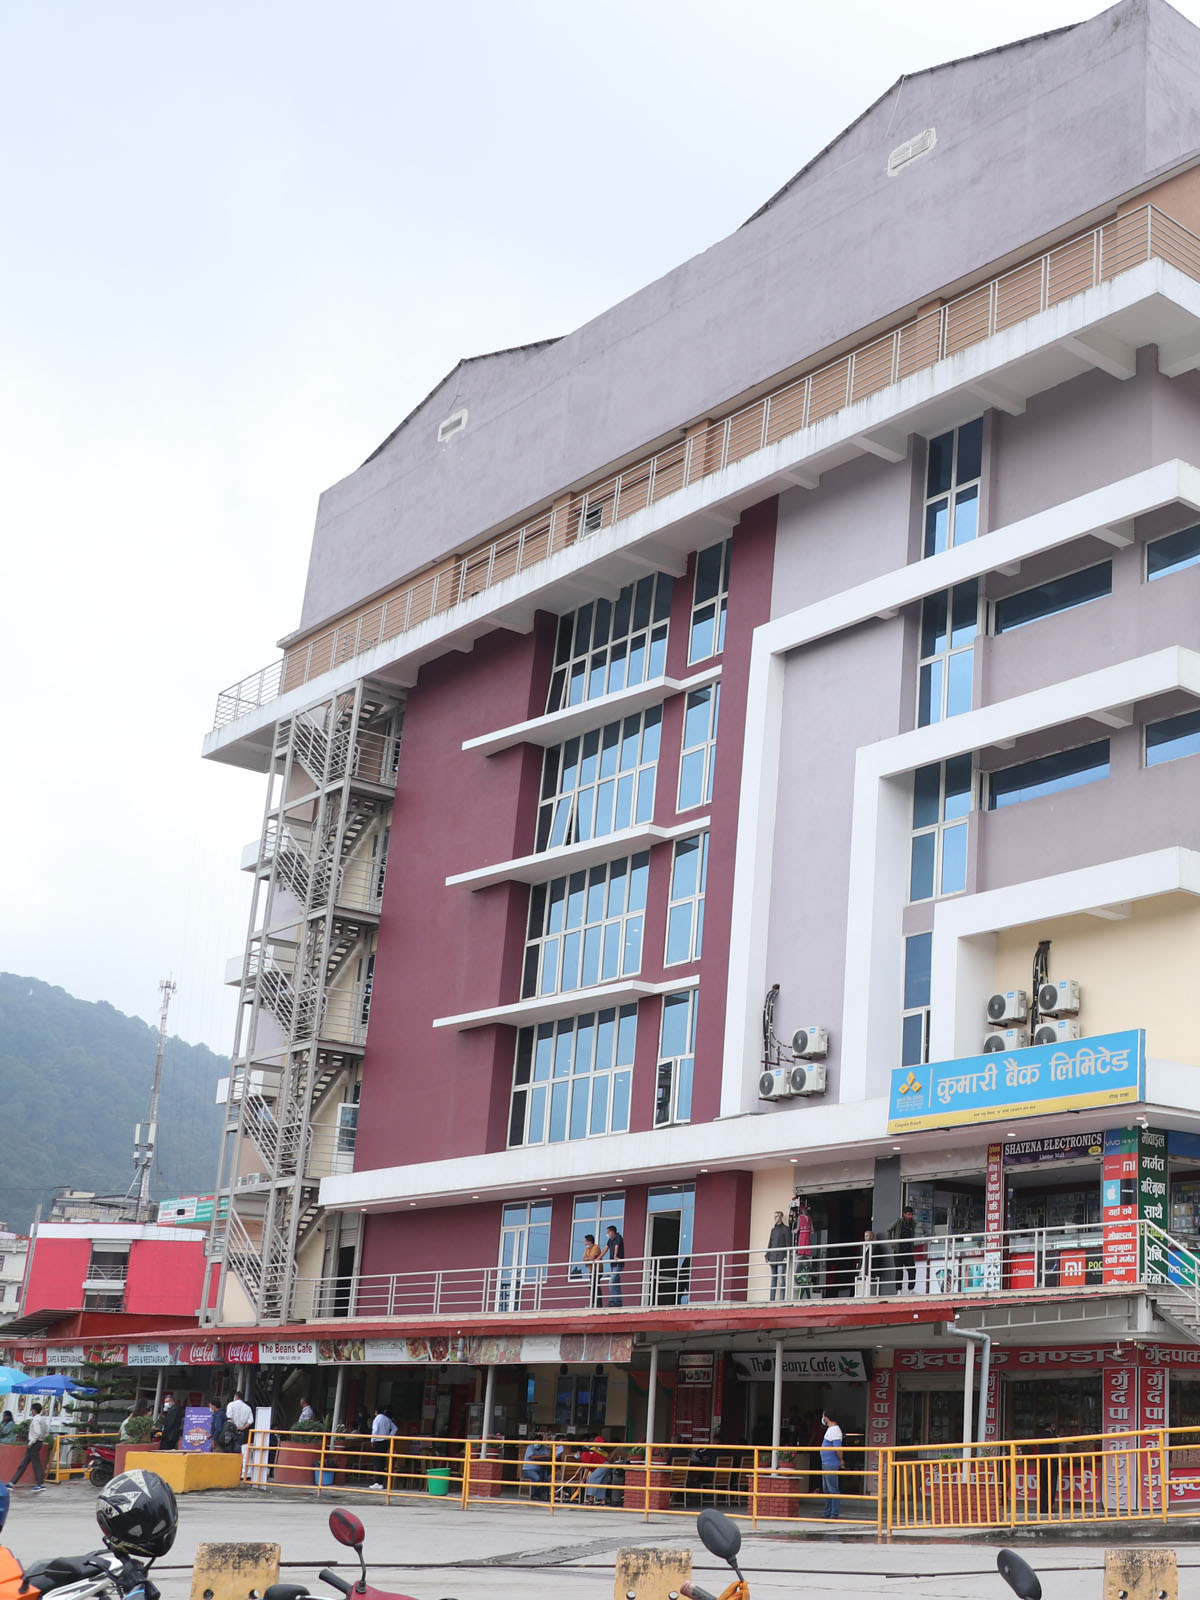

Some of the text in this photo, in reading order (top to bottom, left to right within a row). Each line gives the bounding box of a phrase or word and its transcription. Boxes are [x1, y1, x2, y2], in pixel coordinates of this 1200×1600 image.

[937, 1063, 998, 1104] कुमारी
[1049, 1046, 1132, 1081] लिमिटेड
[1004, 1133, 1103, 1156] SHAYENA ELECTRONICS
[1143, 1202, 1163, 1220] साथै
[261, 1343, 313, 1353] The Beans Cafe
[809, 1356, 836, 1372] Cafe
